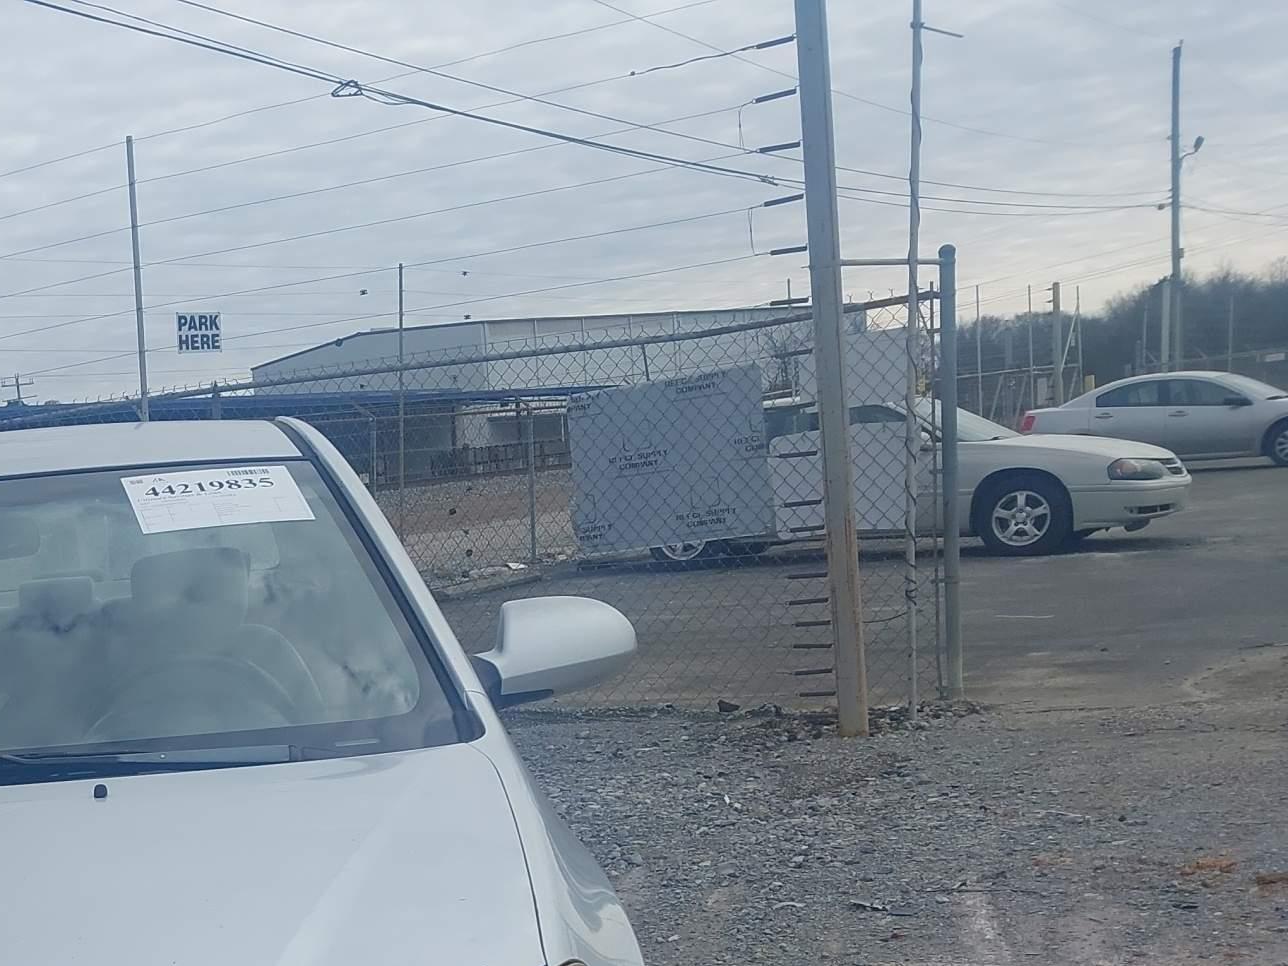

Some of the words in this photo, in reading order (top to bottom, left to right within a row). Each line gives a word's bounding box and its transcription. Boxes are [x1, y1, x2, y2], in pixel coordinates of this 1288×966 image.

[178, 314, 220, 331] PARK
[178, 334, 221, 350] HERE
[144, 477, 274, 497] 44219835
